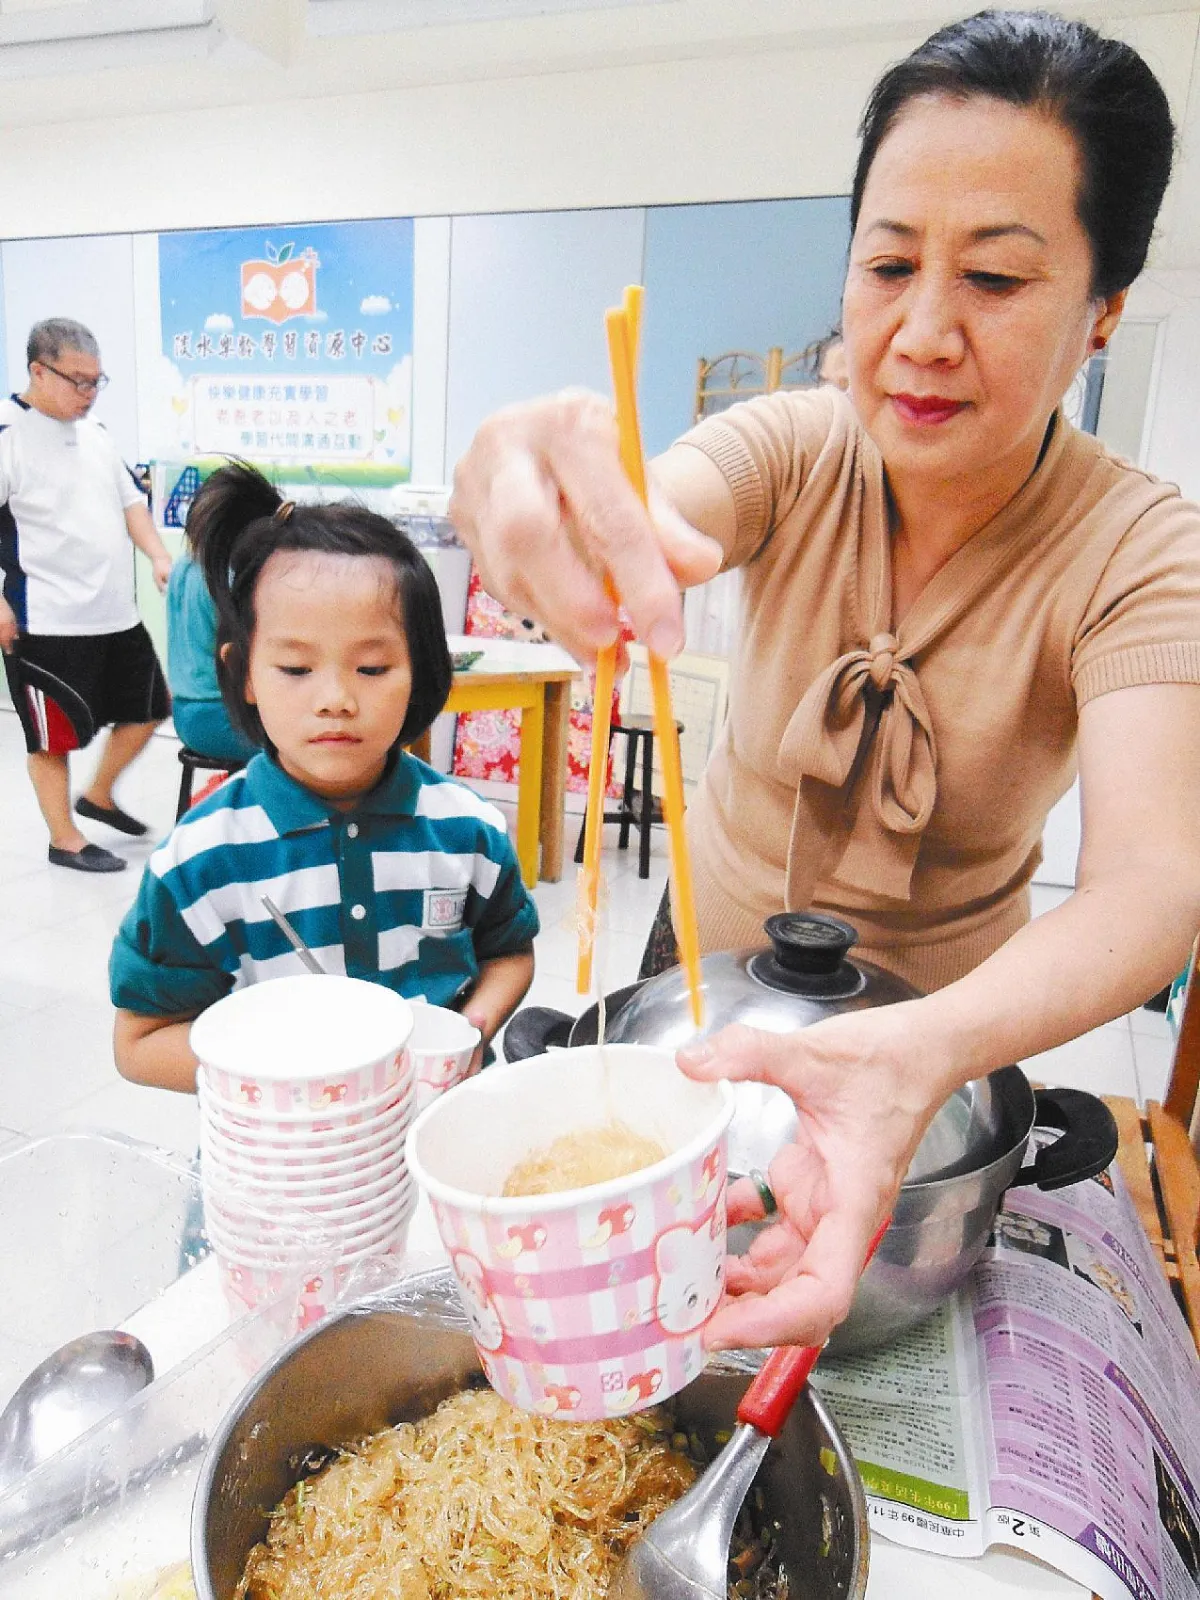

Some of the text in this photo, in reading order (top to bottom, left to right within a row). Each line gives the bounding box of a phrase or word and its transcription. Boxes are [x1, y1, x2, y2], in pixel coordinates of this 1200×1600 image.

[174, 331, 393, 359] 淡水樂齡學習資源中心
[208, 384, 329, 401] 快樂健康充實學習
